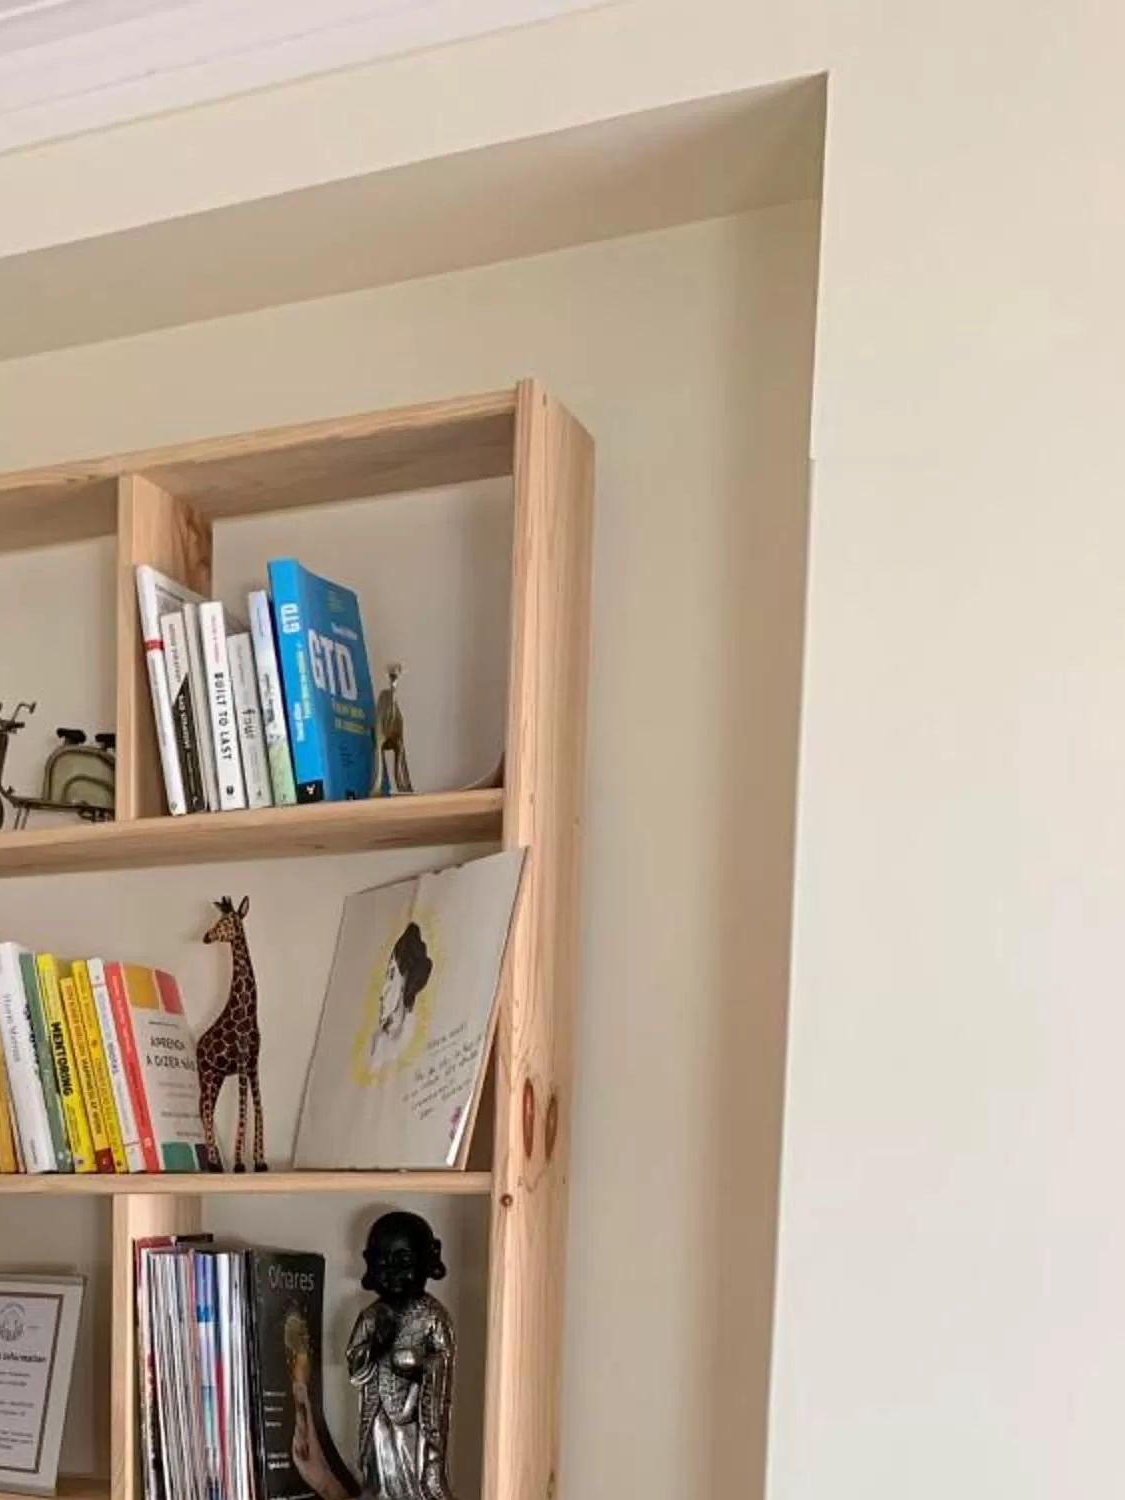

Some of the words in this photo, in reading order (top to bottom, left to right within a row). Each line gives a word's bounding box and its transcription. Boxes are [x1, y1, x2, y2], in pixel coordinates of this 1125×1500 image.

[308, 628, 358, 701] GTD
[214, 672, 227, 706] BUILT
[218, 711, 228, 726] TO
[220, 731, 232, 760] LAST
[50, 1021, 73, 1096] MENTORING
